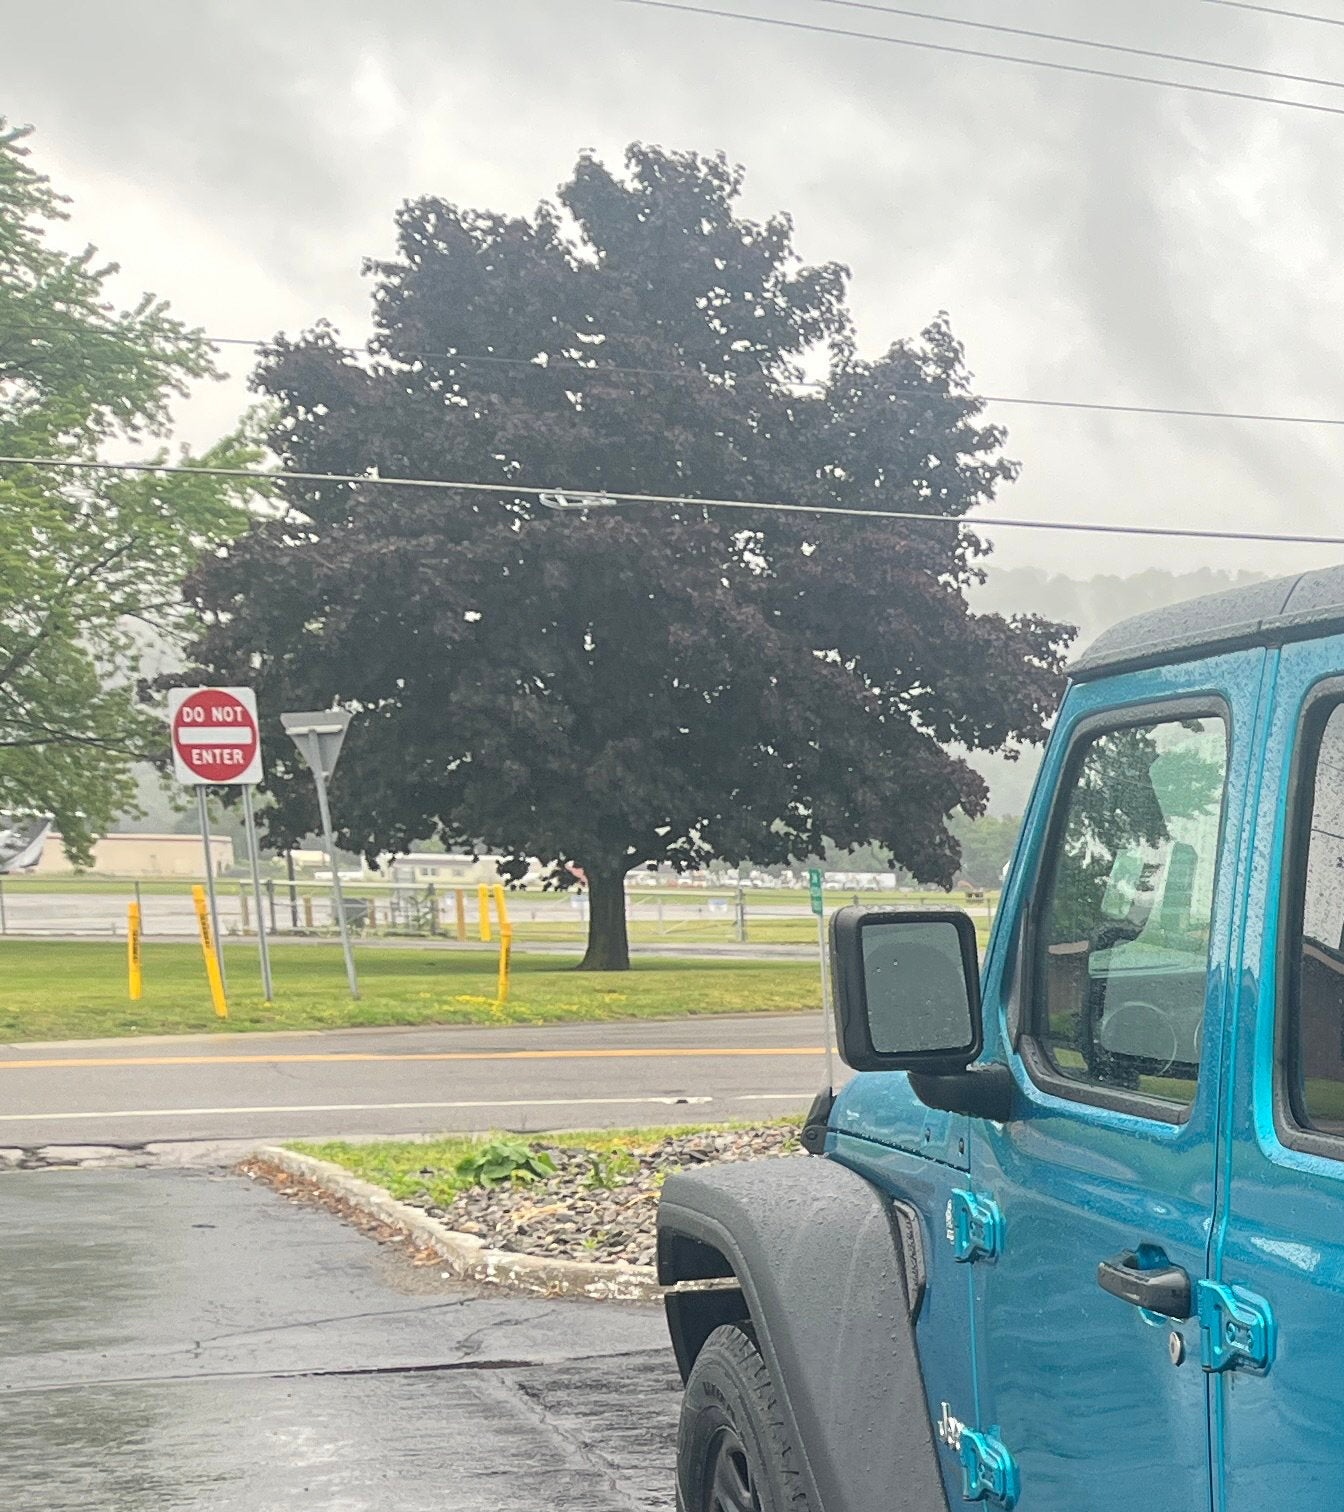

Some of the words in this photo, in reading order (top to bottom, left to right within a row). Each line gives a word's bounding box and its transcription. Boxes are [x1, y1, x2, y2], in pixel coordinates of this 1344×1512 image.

[182, 706, 204, 722] DO
[211, 706, 243, 722] NOT
[191, 748, 244, 765] ENTER
